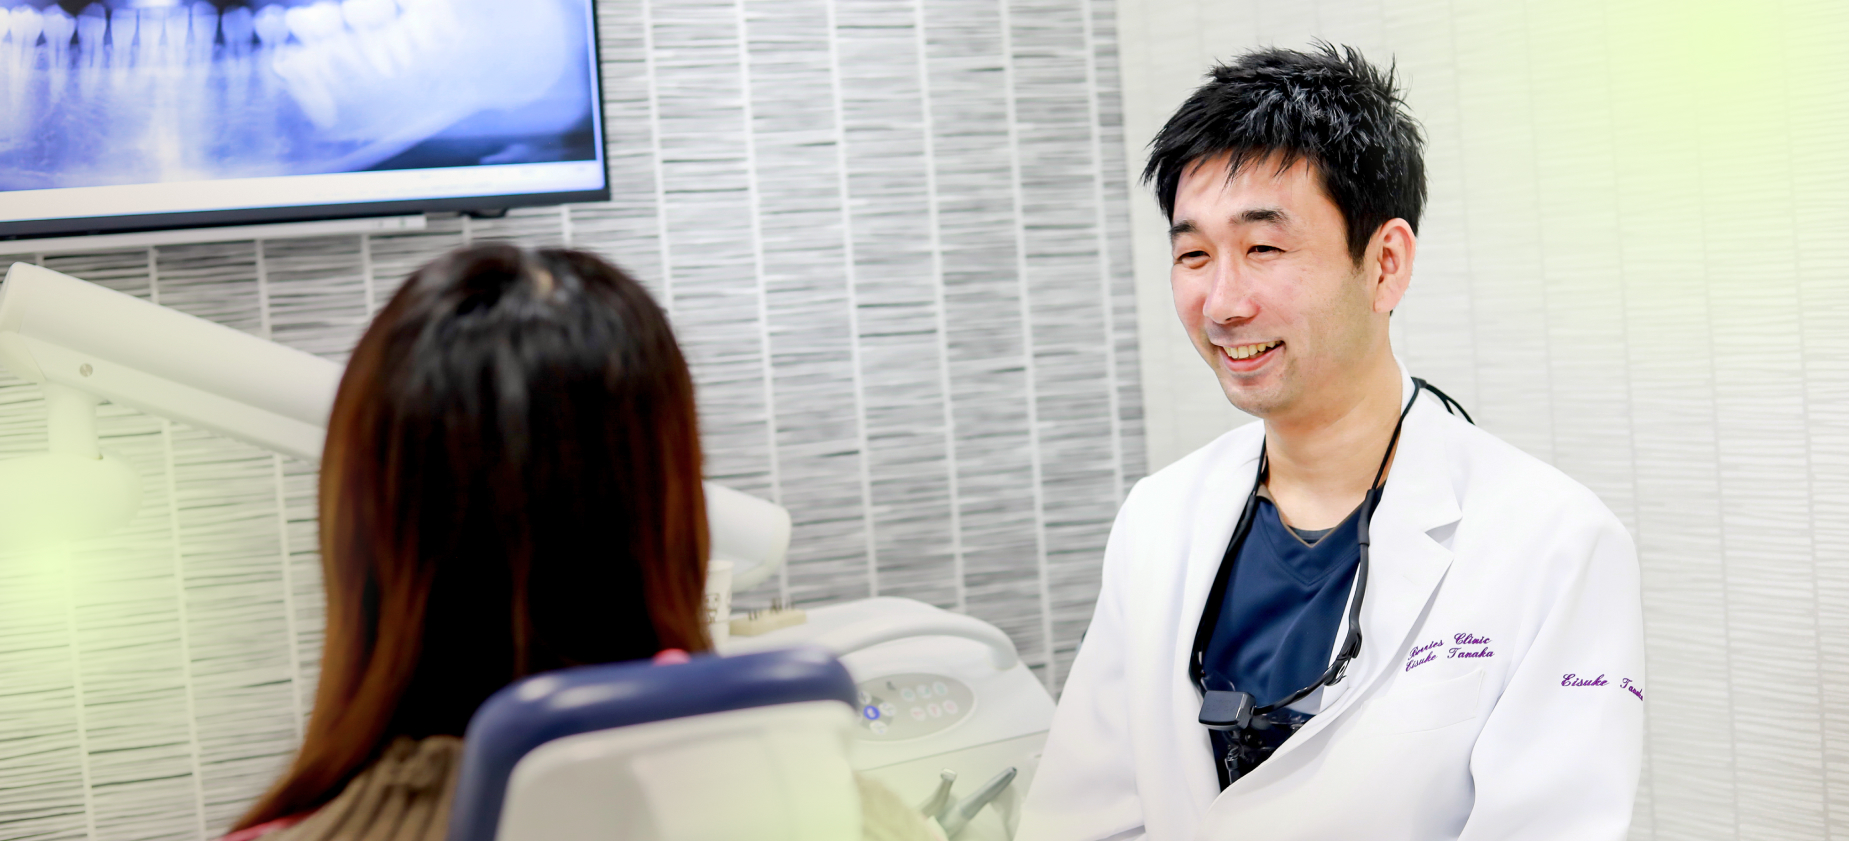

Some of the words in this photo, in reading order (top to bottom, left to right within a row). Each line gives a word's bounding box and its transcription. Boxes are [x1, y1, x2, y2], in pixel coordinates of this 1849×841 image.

[1453, 632, 1492, 645] Clinic
[1405, 651, 1437, 672] Eisuke
[1447, 646, 1495, 659] Tanaka
[1561, 673, 1609, 687] Eisuke
